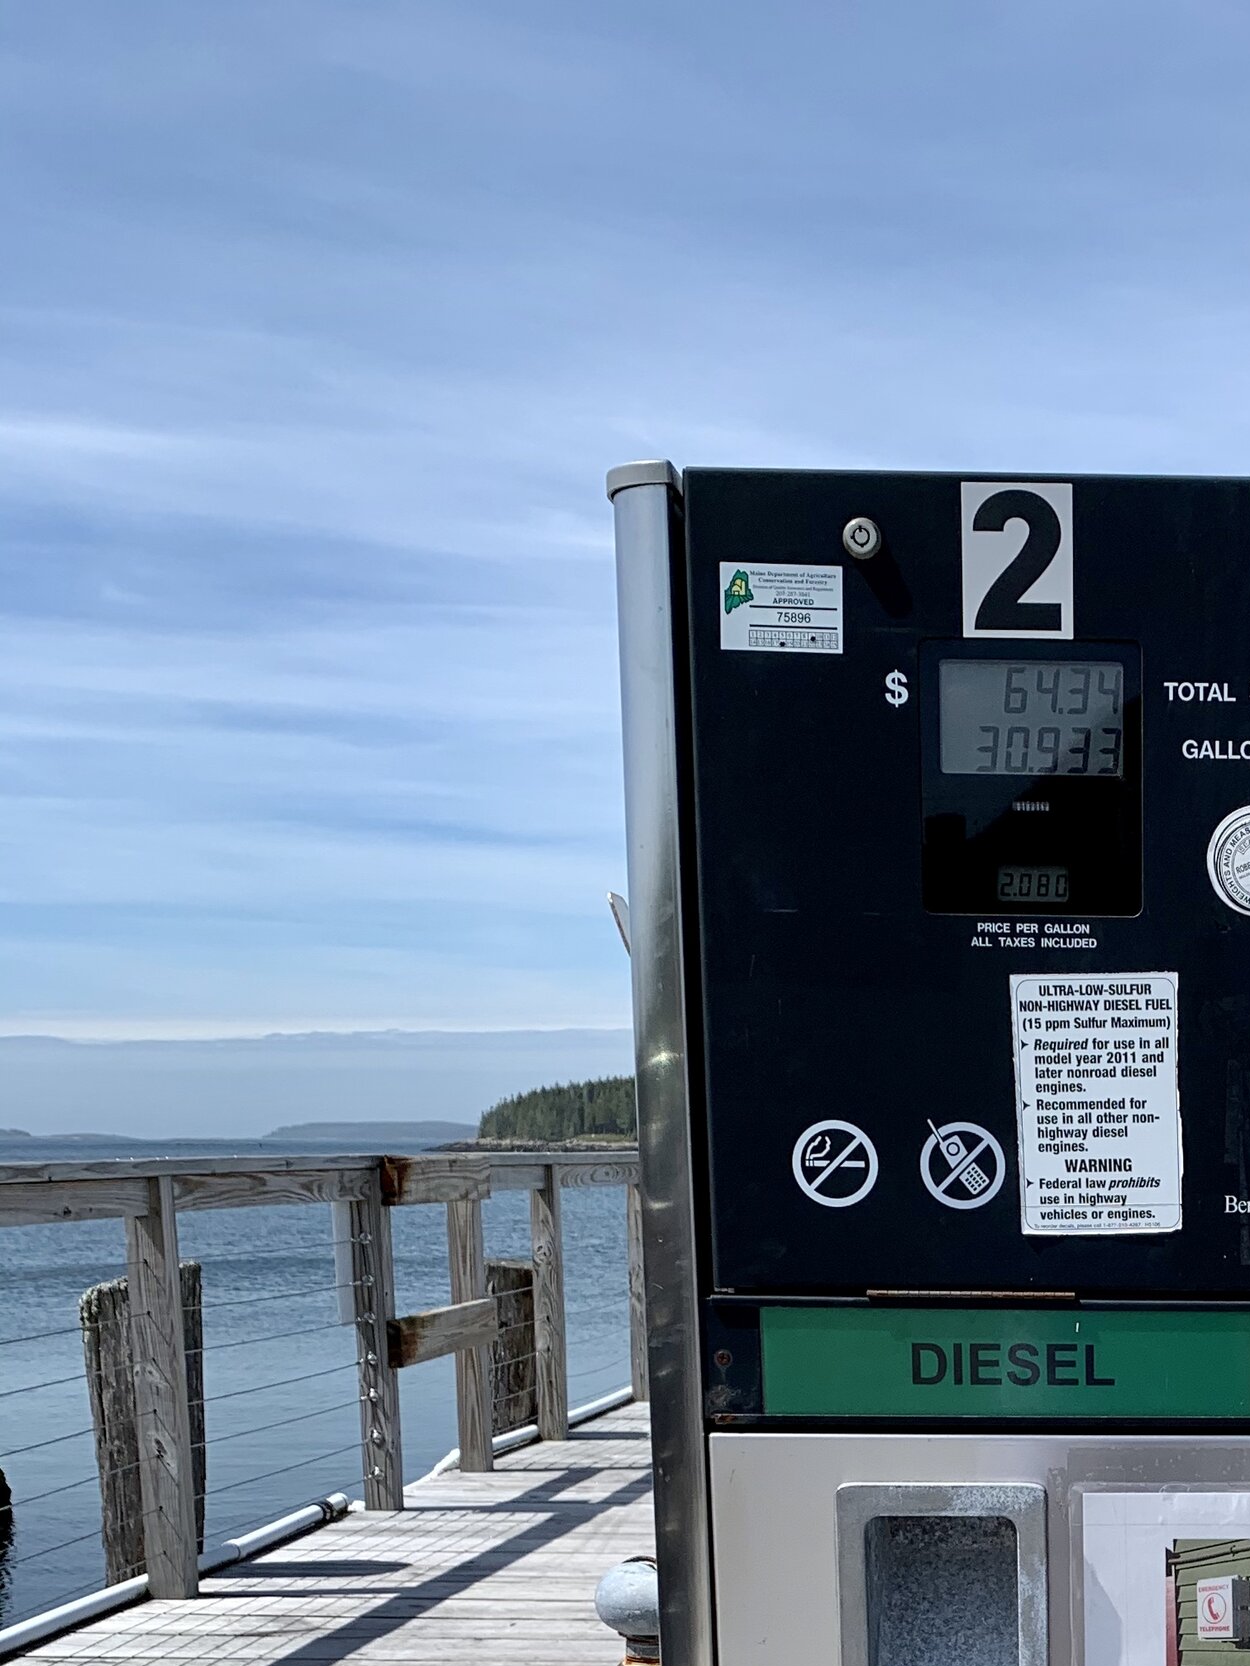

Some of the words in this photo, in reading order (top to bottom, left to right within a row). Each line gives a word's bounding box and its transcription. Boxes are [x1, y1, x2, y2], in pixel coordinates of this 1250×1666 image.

[972, 489, 1063, 631] 2
[772, 598, 814, 606] APPROVED
[776, 612, 811, 623] 75896
[885, 669, 909, 708] $
[1004, 667, 1121, 714] 64.34
[1164, 682, 1236, 703] TOTAL
[976, 725, 1122, 773] 30.933
[1224, 848, 1232, 868] AND
[1000, 872, 1068, 898] 2.080
[1224, 871, 1250, 904] WEIGHTS
[977, 922, 1011, 935] PRICE
[1016, 922, 1040, 935] PER
[1044, 923, 1090, 936] GALLON
[971, 936, 994, 948] ALL
[999, 936, 1036, 948] TAXES
[1040, 937, 1097, 949] INCLUDED
[1038, 984, 1152, 997] ULTRA-LOW-SULFUR
[1019, 1000, 1099, 1012] NON-HIGHWAY
[1104, 999, 1142, 1011] DIESEL
[1145, 998, 1172, 1010] FUEL
[1022, 1018, 1041, 1032] (15
[1046, 1020, 1070, 1032] ppm
[1074, 1017, 1107, 1029] Sulfur
[1111, 1016, 1170, 1030] Maximum)
[1034, 1038, 1088, 1053] Required
[1092, 1038, 1110, 1050] for
[1114, 1040, 1135, 1050] use
[1139, 1038, 1150, 1049] in
[1155, 1037, 1169, 1049] all
[1034, 1053, 1072, 1065] model
[1076, 1055, 1102, 1066] year
[1106, 1052, 1136, 1064] 2011
[1142, 1052, 1164, 1063] and
[1035, 1067, 1063, 1079] later
[1067, 1066, 1116, 1078] nonroad
[1121, 1066, 1157, 1077] diesel
[1036, 1082, 1086, 1095] engines.
[1036, 1098, 1126, 1111] Recommended
[1130, 1098, 1147, 1109] for
[1037, 1115, 1058, 1124] use
[1062, 1113, 1073, 1124] in
[1078, 1113, 1092, 1124] all
[1096, 1113, 1128, 1123] other
[1132, 1114, 1160, 1123] non-
[1038, 1126, 1088, 1140] highway
[1092, 1126, 1128, 1138] diesel
[1038, 1141, 1088, 1154] engines.
[1065, 1158, 1132, 1173] WARNING
[1039, 1178, 1082, 1189] Federal
[1086, 1178, 1106, 1188] law
[1108, 1177, 1161, 1190] prohibits
[1040, 1195, 1060, 1205] use
[1064, 1193, 1074, 1204] in
[1079, 1192, 1127, 1206] highway
[1040, 1209, 1087, 1220] vehicles
[1091, 1210, 1104, 1219] or
[1108, 1208, 1155, 1221] engines.
[911, 1342, 1115, 1387] DIESEL
